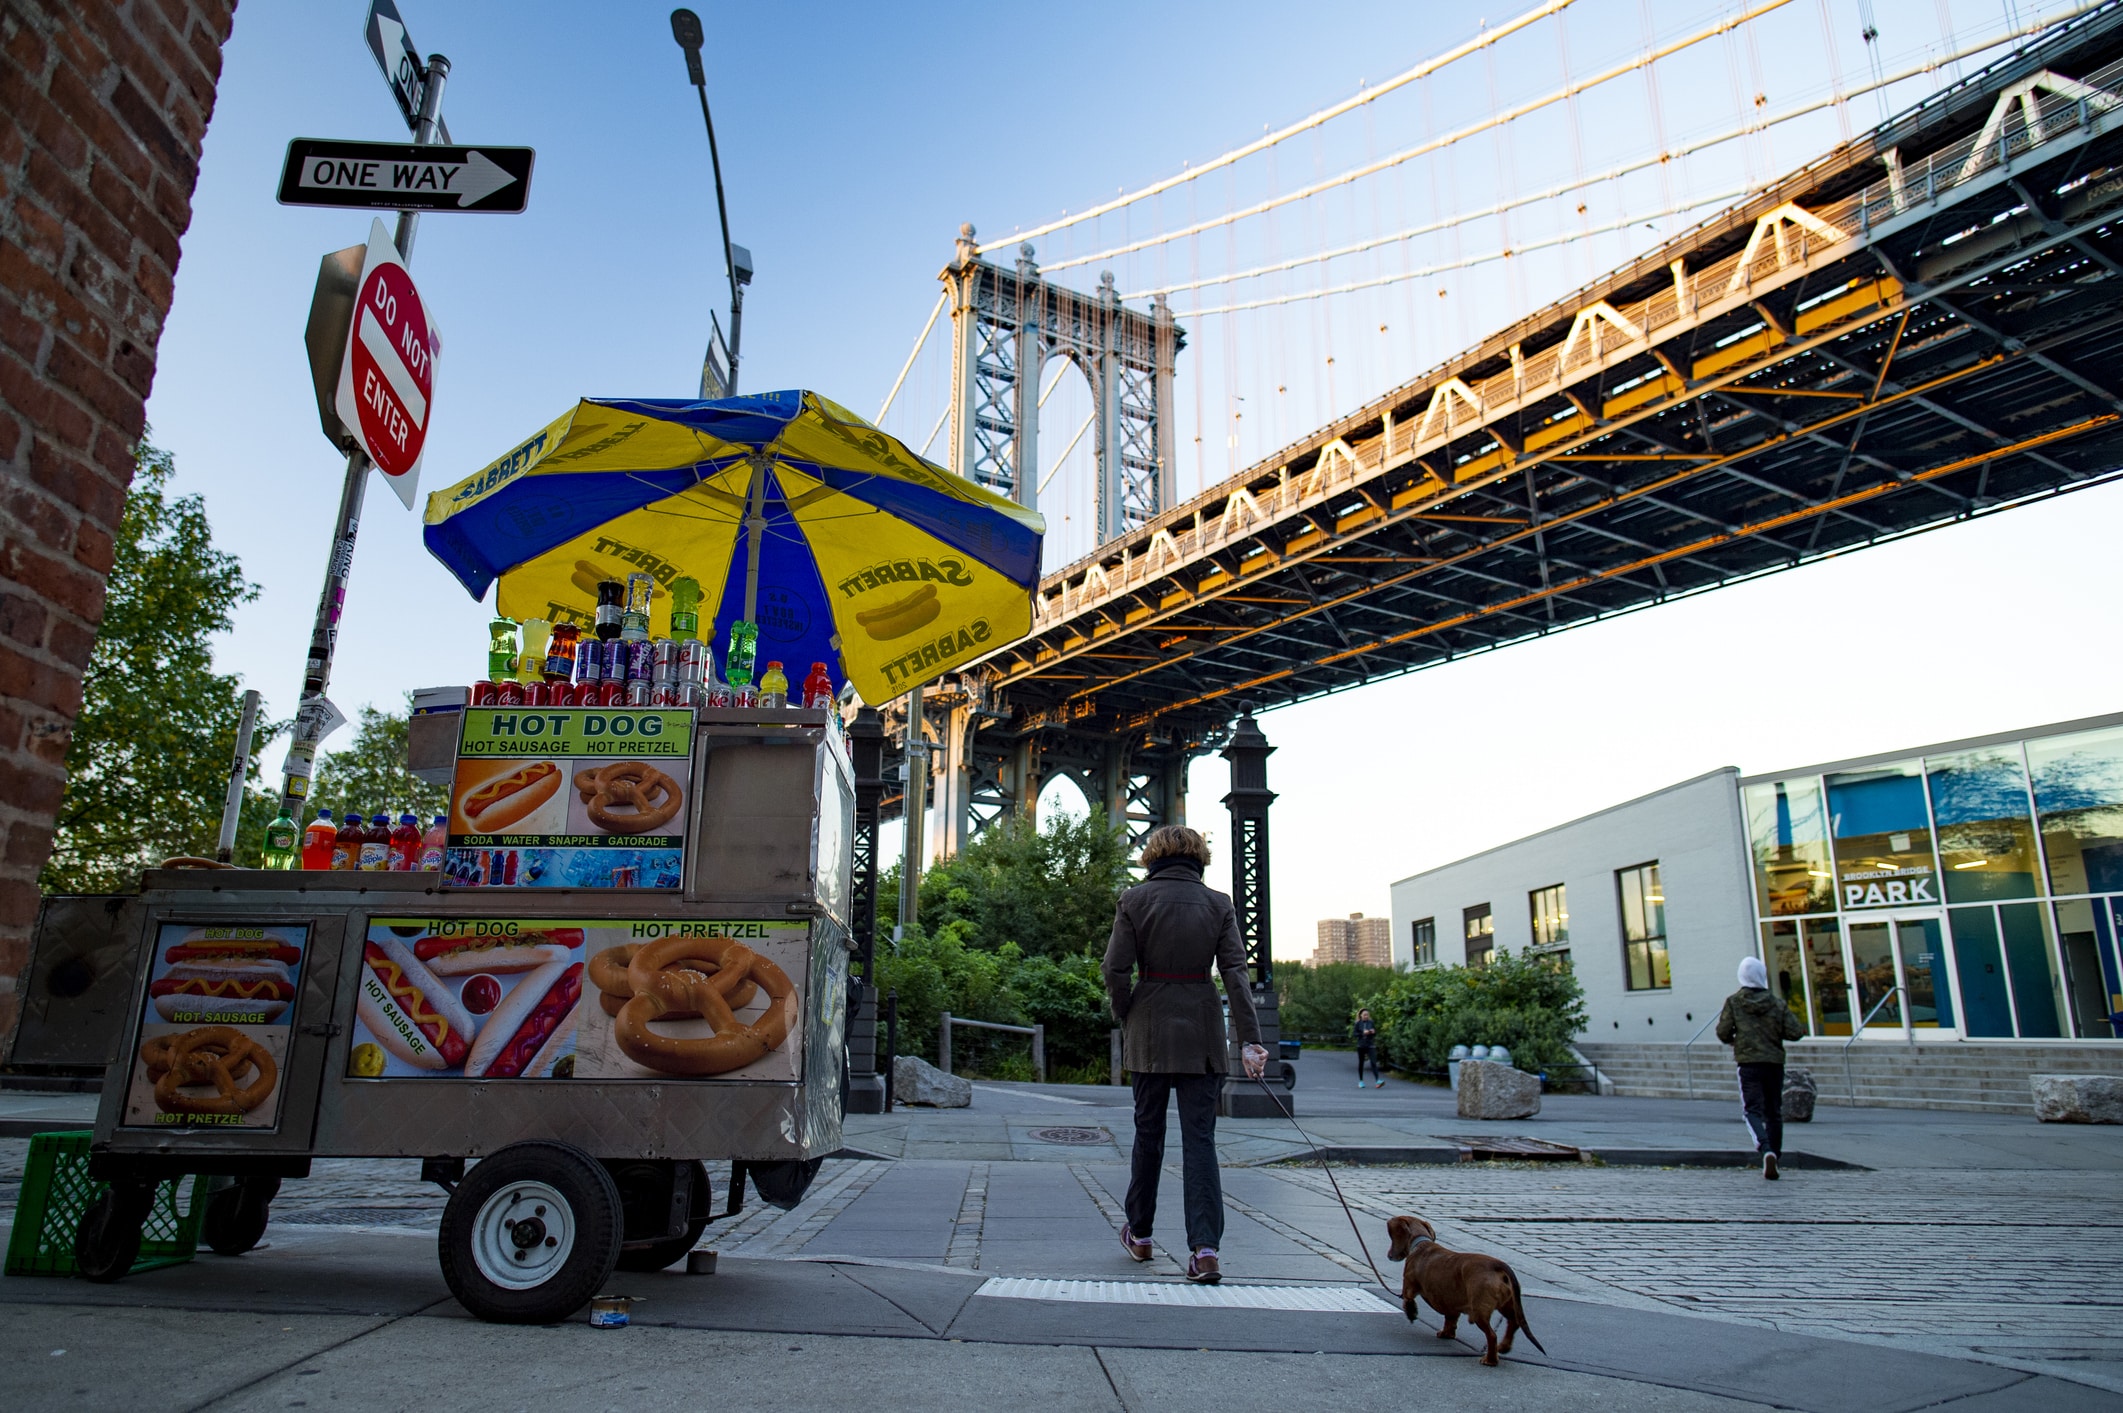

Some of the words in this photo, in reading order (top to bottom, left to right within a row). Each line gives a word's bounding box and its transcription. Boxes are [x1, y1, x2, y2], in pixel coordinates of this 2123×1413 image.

[313, 160, 380, 187] ONE
[393, 164, 461, 190] WAY
[375, 276, 397, 326] DO
[401, 321, 428, 379] NOT
[363, 368, 409, 453] ENTER
[452, 431, 548, 502] SABRETT
[491, 714, 570, 736] HOT
[582, 714, 663, 736] DOG
[464, 741, 495, 753] HOT
[498, 741, 570, 753] SAUSAGE
[587, 741, 615, 753] HOT
[619, 741, 679, 753] PRETZEL
[463, 836, 494, 846] SODA
[502, 836, 540, 846] WATER
[548, 836, 600, 847] SNAPPLE
[608, 836, 668, 847] GATORADE
[1843, 870, 1893, 881] BROOKLYN
[1894, 866, 1930, 877] BRIDGE
[1844, 878, 1936, 908] PARK
[205, 928, 231, 939] HOT
[236, 928, 264, 939] DOG
[428, 921, 469, 936] HOT
[475, 922, 519, 937] DOG
[632, 923, 673, 938] HOT
[680, 923, 770, 938] PRETZEL
[173, 1011, 201, 1023] HOT
[204, 1012, 266, 1024] SAUSAGE
[365, 979, 387, 1004] HOT
[383, 1002, 426, 1056] SAUSAGE
[155, 1113, 183, 1124] HOT
[187, 1113, 245, 1125] PRETZEL
